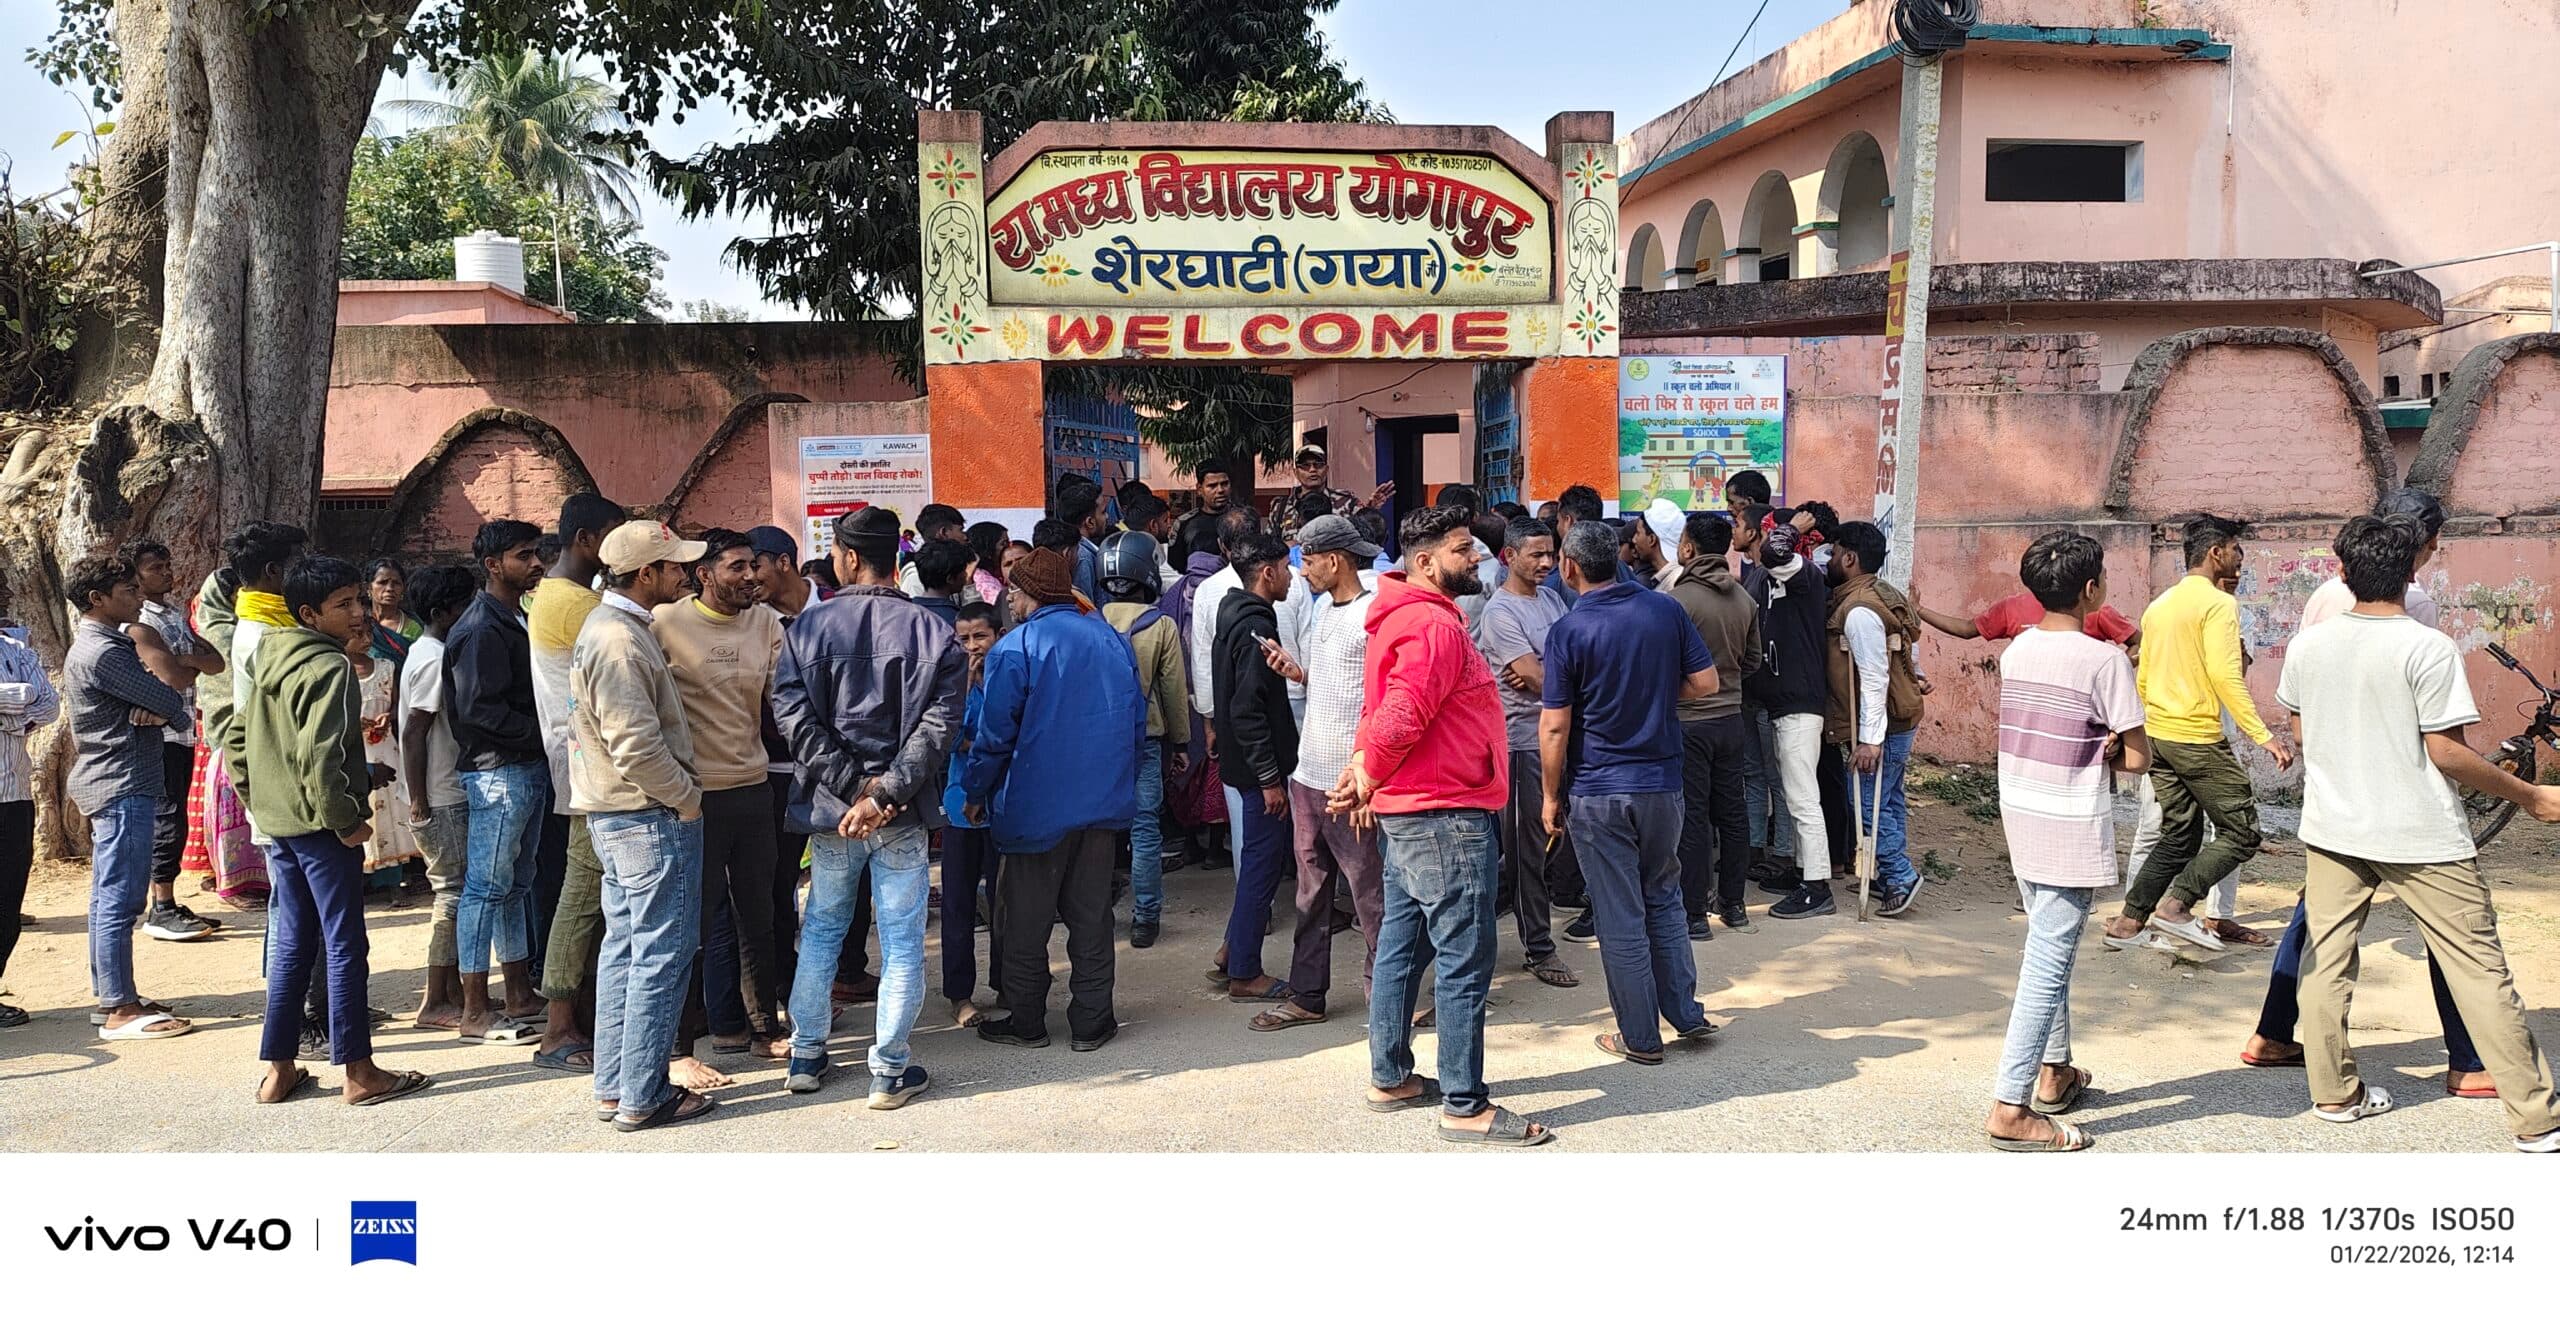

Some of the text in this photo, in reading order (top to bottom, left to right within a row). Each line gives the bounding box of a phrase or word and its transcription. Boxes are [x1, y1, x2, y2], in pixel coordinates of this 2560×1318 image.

[1134, 152, 1344, 220] विद्यालय
[1091, 235, 1288, 294] शेरघाटी
[1046, 312, 1510, 357] WELCOME
[1624, 393, 1779, 416] चलो फिर से स्कूल चले हम
[1692, 428, 1720, 437] SCHOOL
[882, 442, 917, 450] KAWACH
[859, 459, 869, 468] की
[808, 470, 828, 484] चुप्पी
[854, 471, 871, 480] बाल
[873, 468, 898, 480] विवाह
[900, 468, 922, 479] रोको!
